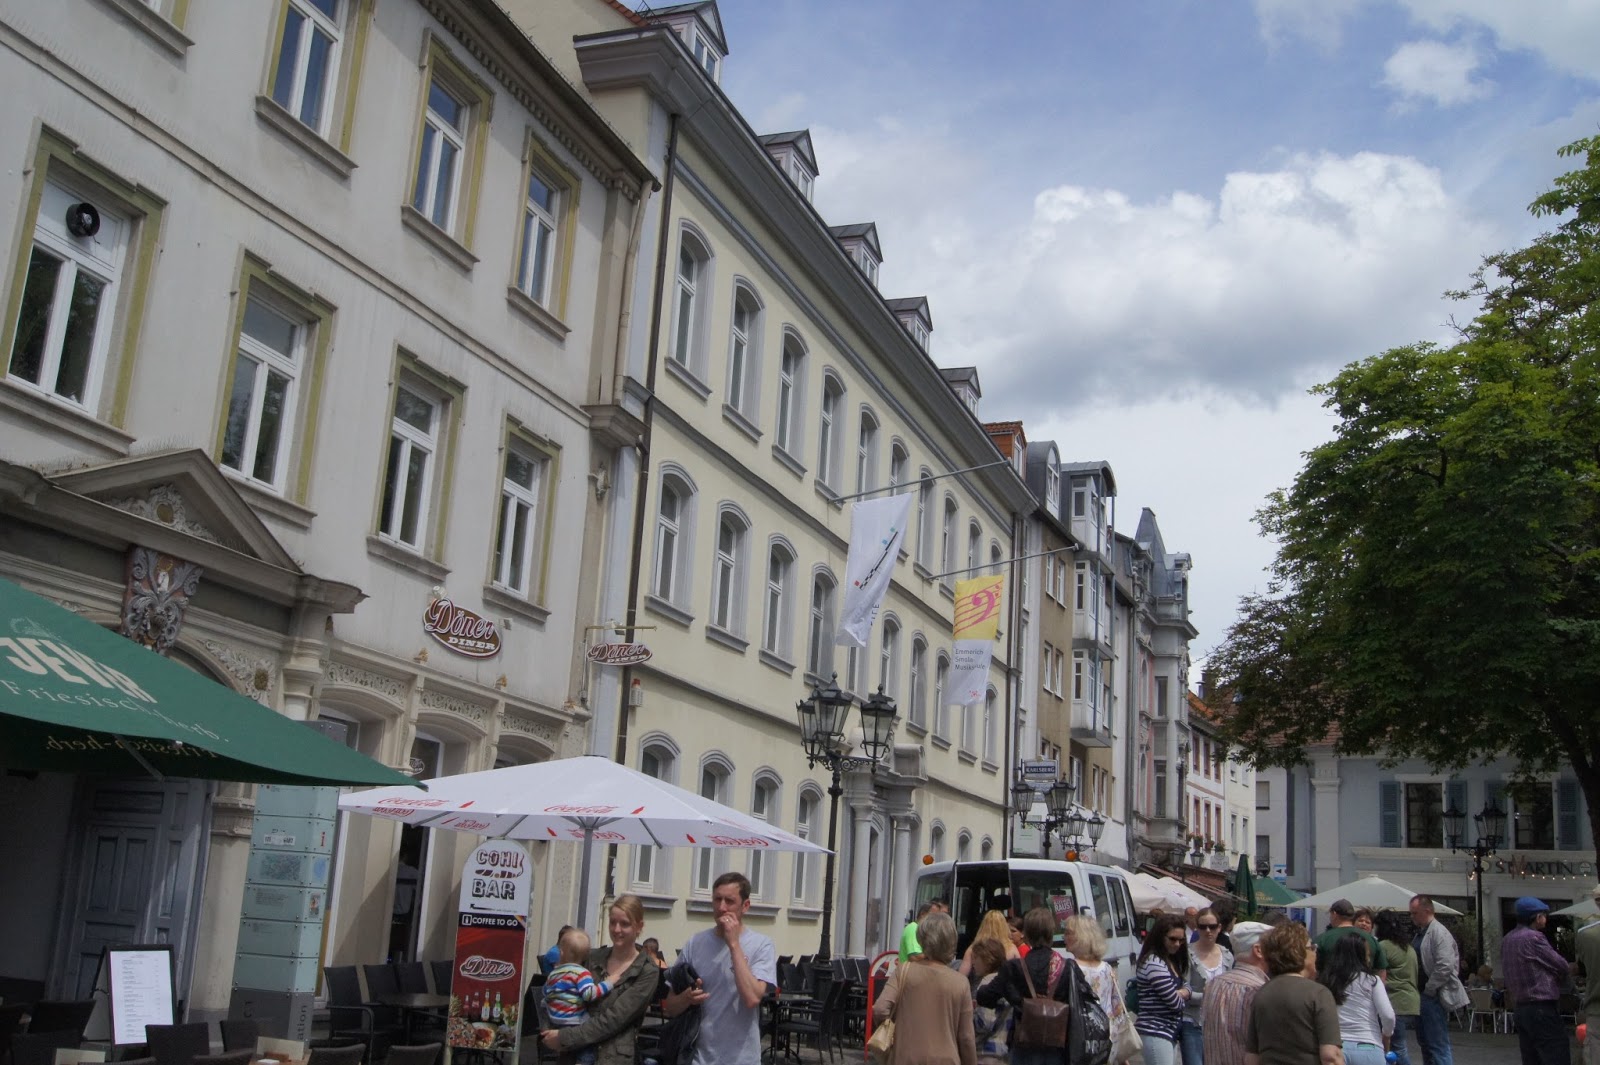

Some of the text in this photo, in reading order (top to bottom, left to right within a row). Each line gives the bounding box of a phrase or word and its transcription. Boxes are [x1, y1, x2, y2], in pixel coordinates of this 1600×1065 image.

[425, 598, 494, 640] Döner
[448, 636, 496, 651] DINER
[472, 878, 516, 900] BAR
[472, 917, 518, 927] COFFEE TO GO
[461, 955, 513, 976] Diner
